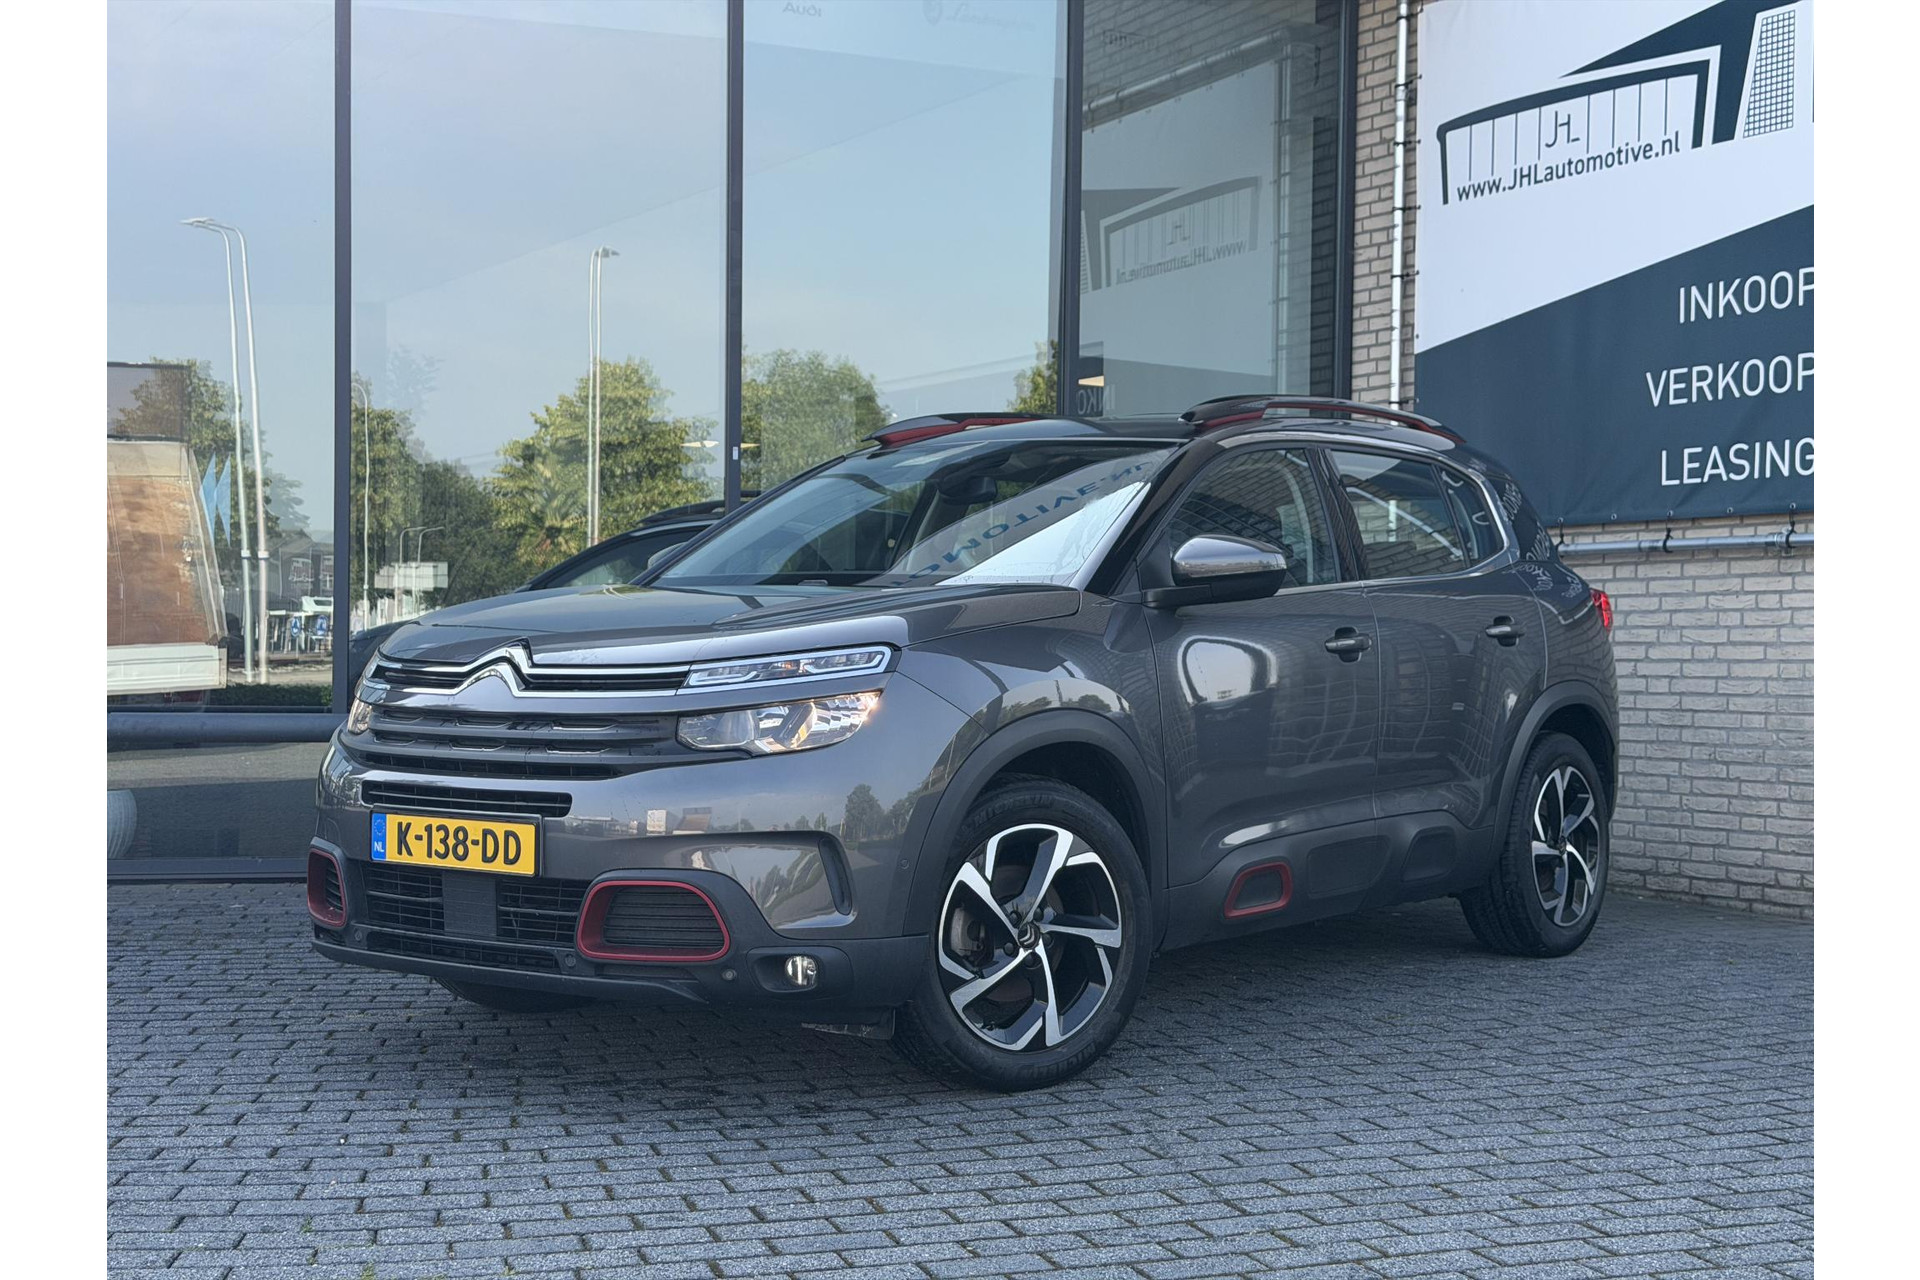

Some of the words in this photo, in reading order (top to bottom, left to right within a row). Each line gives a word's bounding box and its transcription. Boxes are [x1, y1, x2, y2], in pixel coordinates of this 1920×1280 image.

[1456, 131, 1681, 202] www.JHLautomotive.nl
[374, 841, 385, 852] NL
[397, 821, 522, 866] K-138-DD
